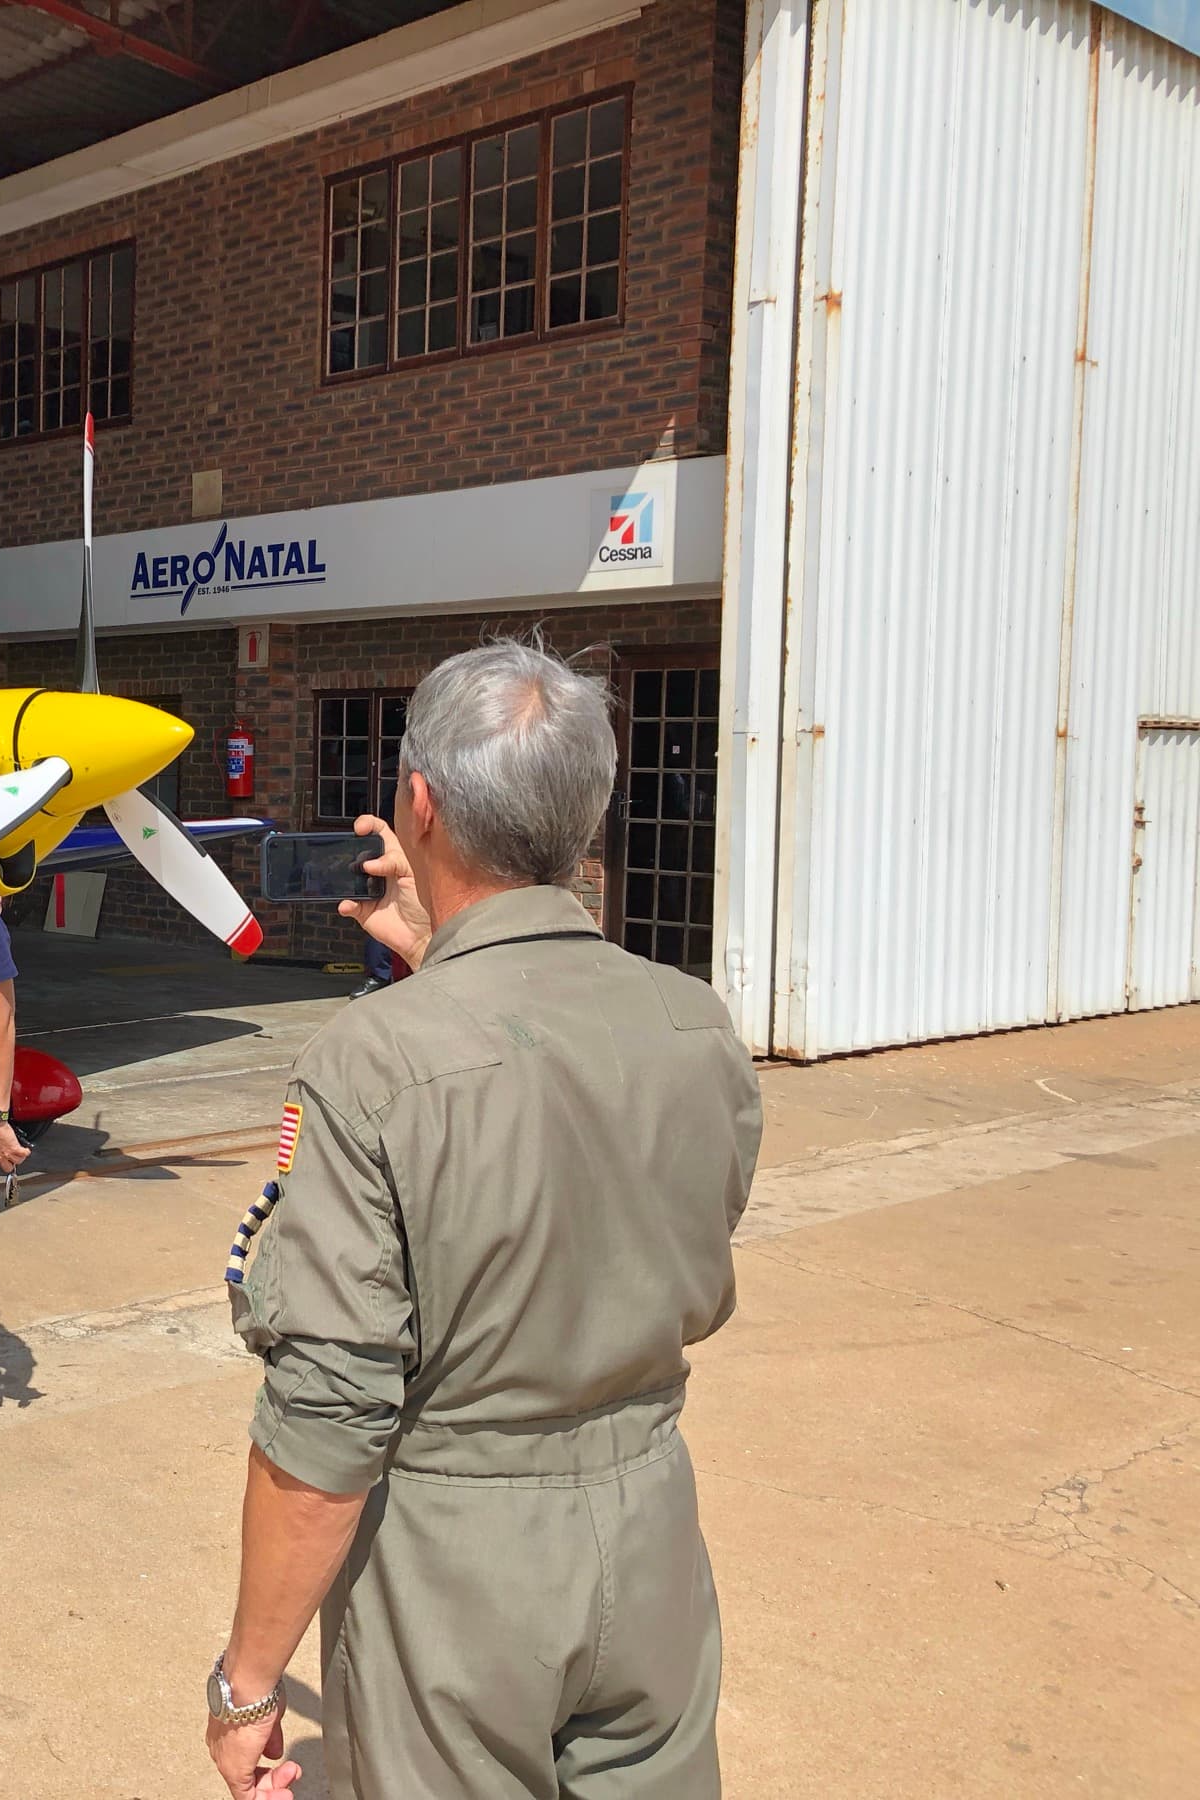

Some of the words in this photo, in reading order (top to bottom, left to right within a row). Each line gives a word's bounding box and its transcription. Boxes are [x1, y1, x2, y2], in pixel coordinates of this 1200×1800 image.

[224, 539, 326, 582] NATAL
[599, 545, 653, 563] Cessna
[197, 586, 211, 596] EST.
[212, 585, 230, 595] 1946
